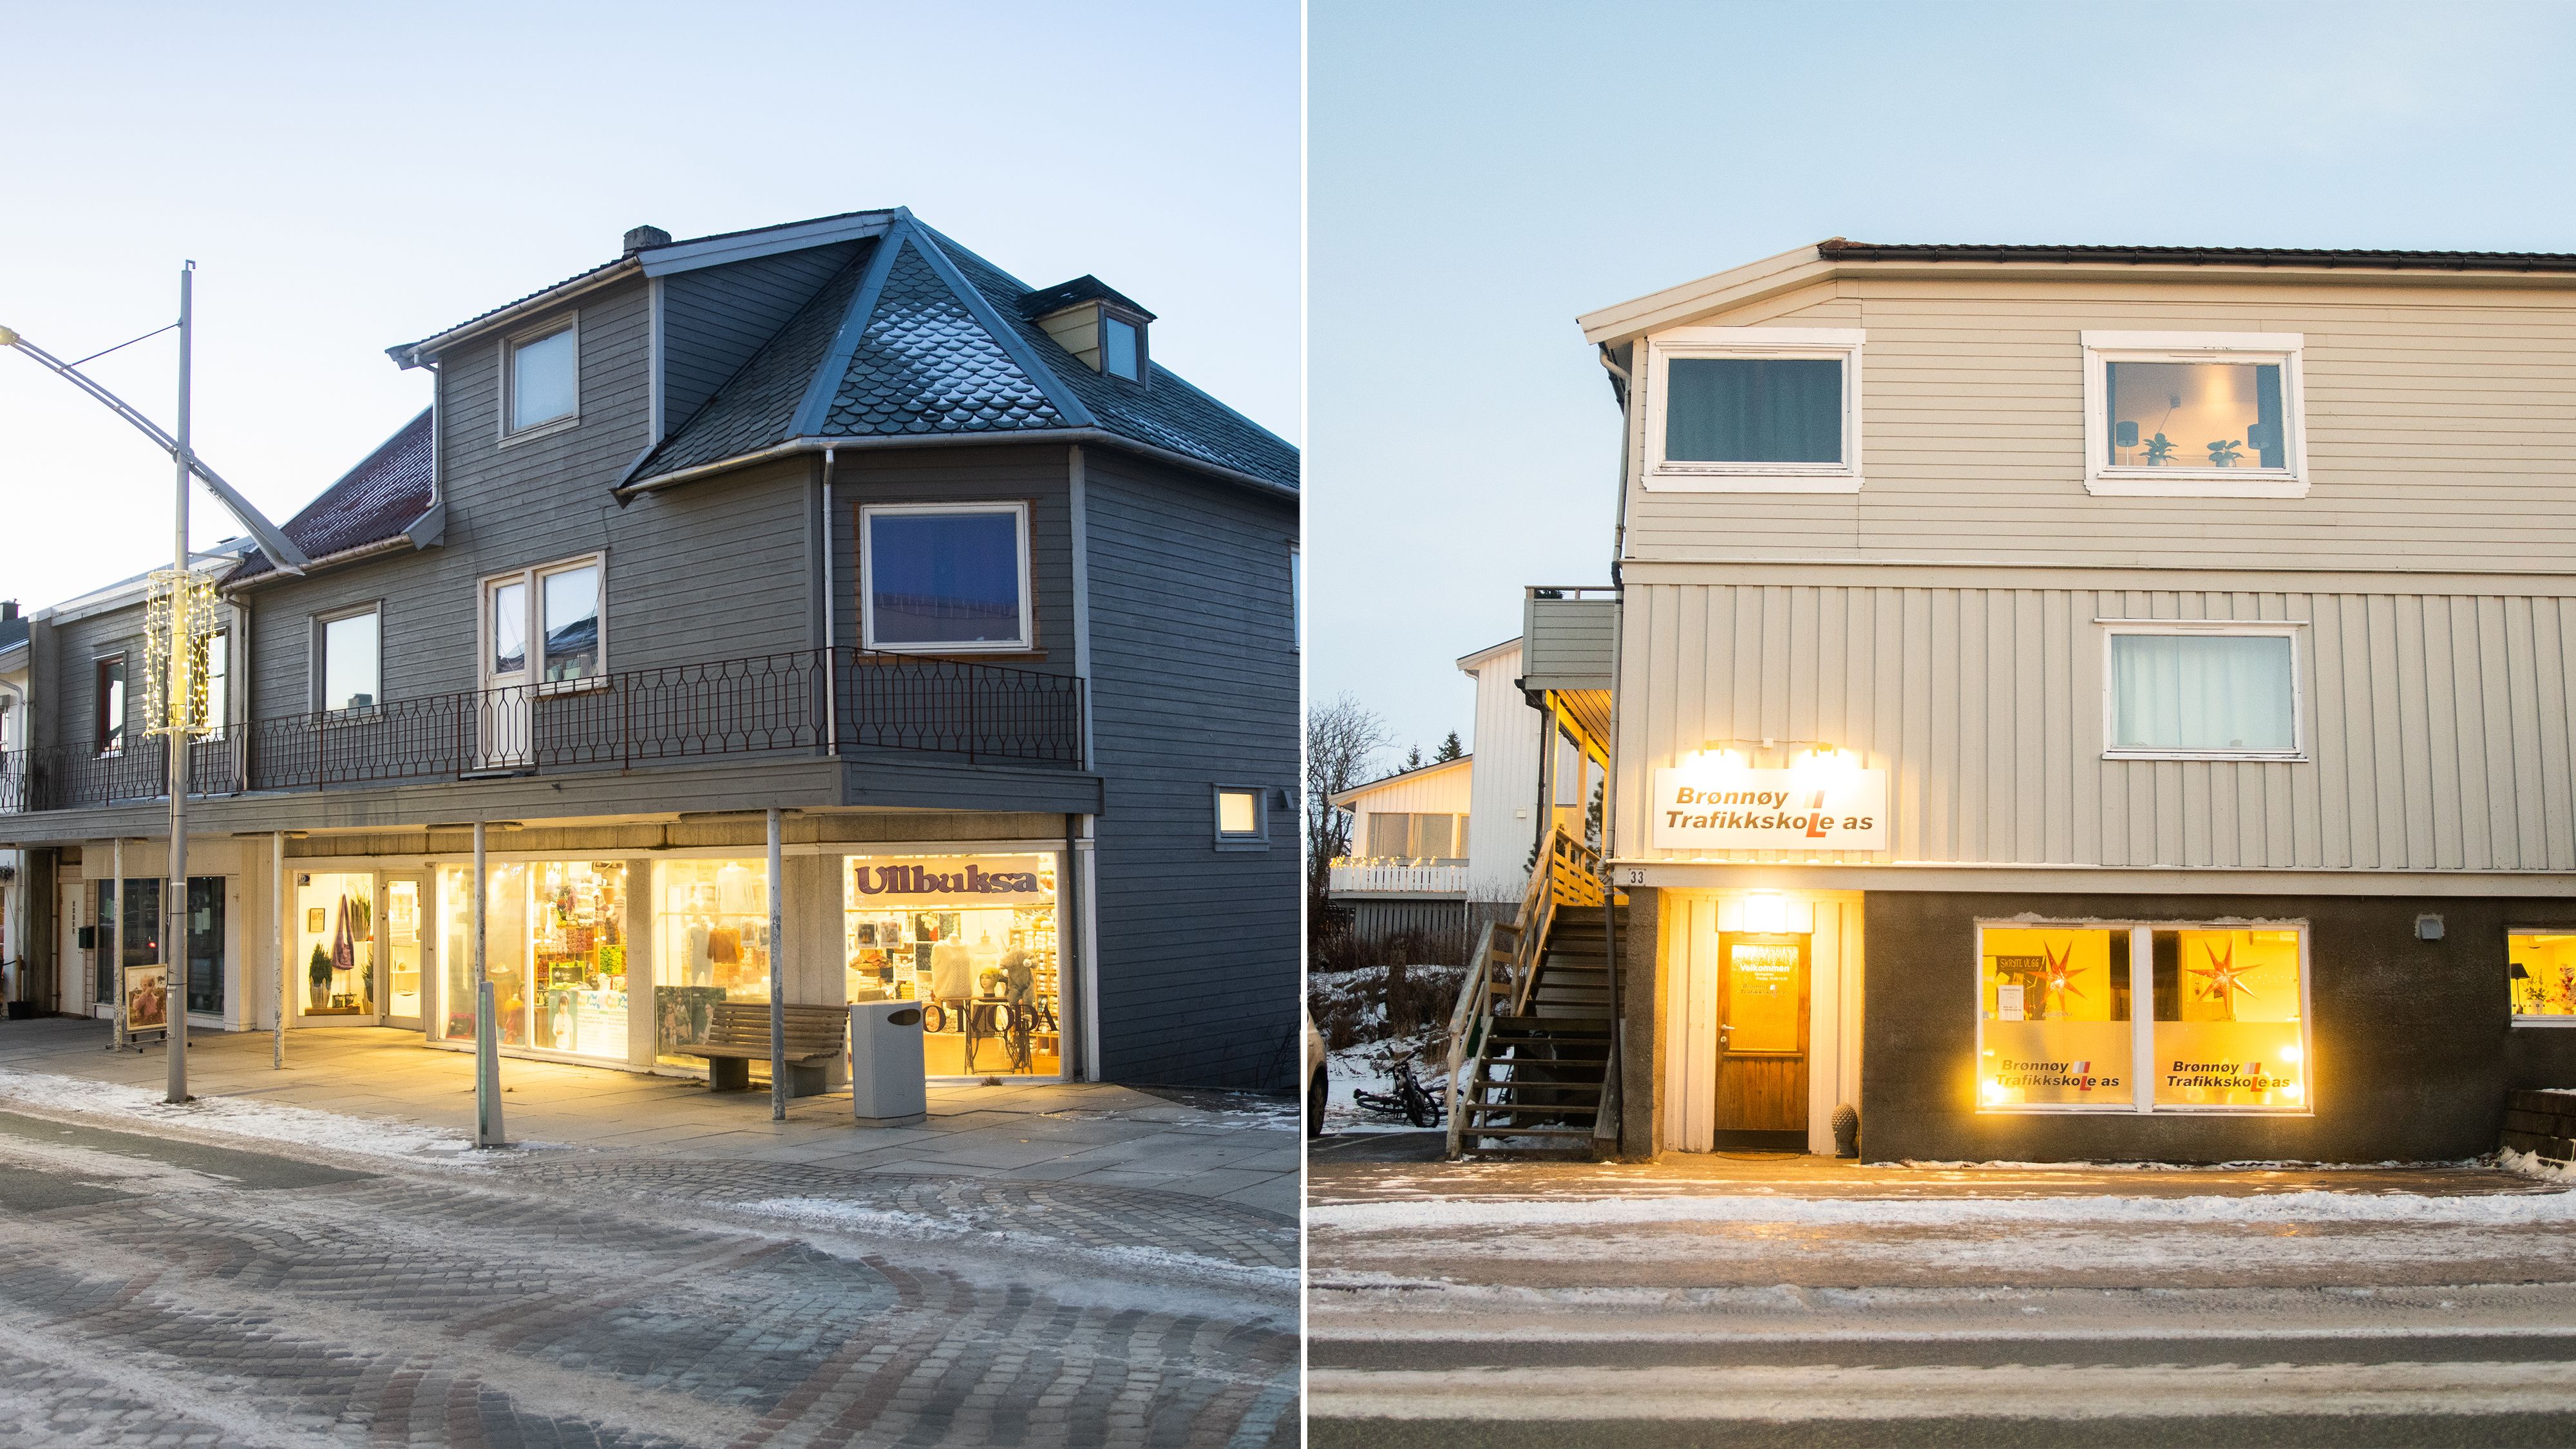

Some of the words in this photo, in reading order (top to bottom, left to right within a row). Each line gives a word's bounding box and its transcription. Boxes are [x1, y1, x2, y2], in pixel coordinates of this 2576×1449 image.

[1676, 787, 1789, 809] Brønnøy
[1842, 816, 1873, 829] as
[855, 864, 1039, 895] Ullbuksa
[1631, 871, 1643, 884] 33
[1740, 963, 1790, 972] Velkommen
[2000, 958, 2023, 968] SKRYTE
[2023, 958, 2040, 967] VEGG
[954, 1004, 1060, 1032] MODA
[2002, 1059, 2069, 1074] Brønnøy
[2173, 1061, 2240, 1075] Brønnøy
[2101, 1077, 2119, 1086] as
[2271, 1078, 2290, 1087] as
